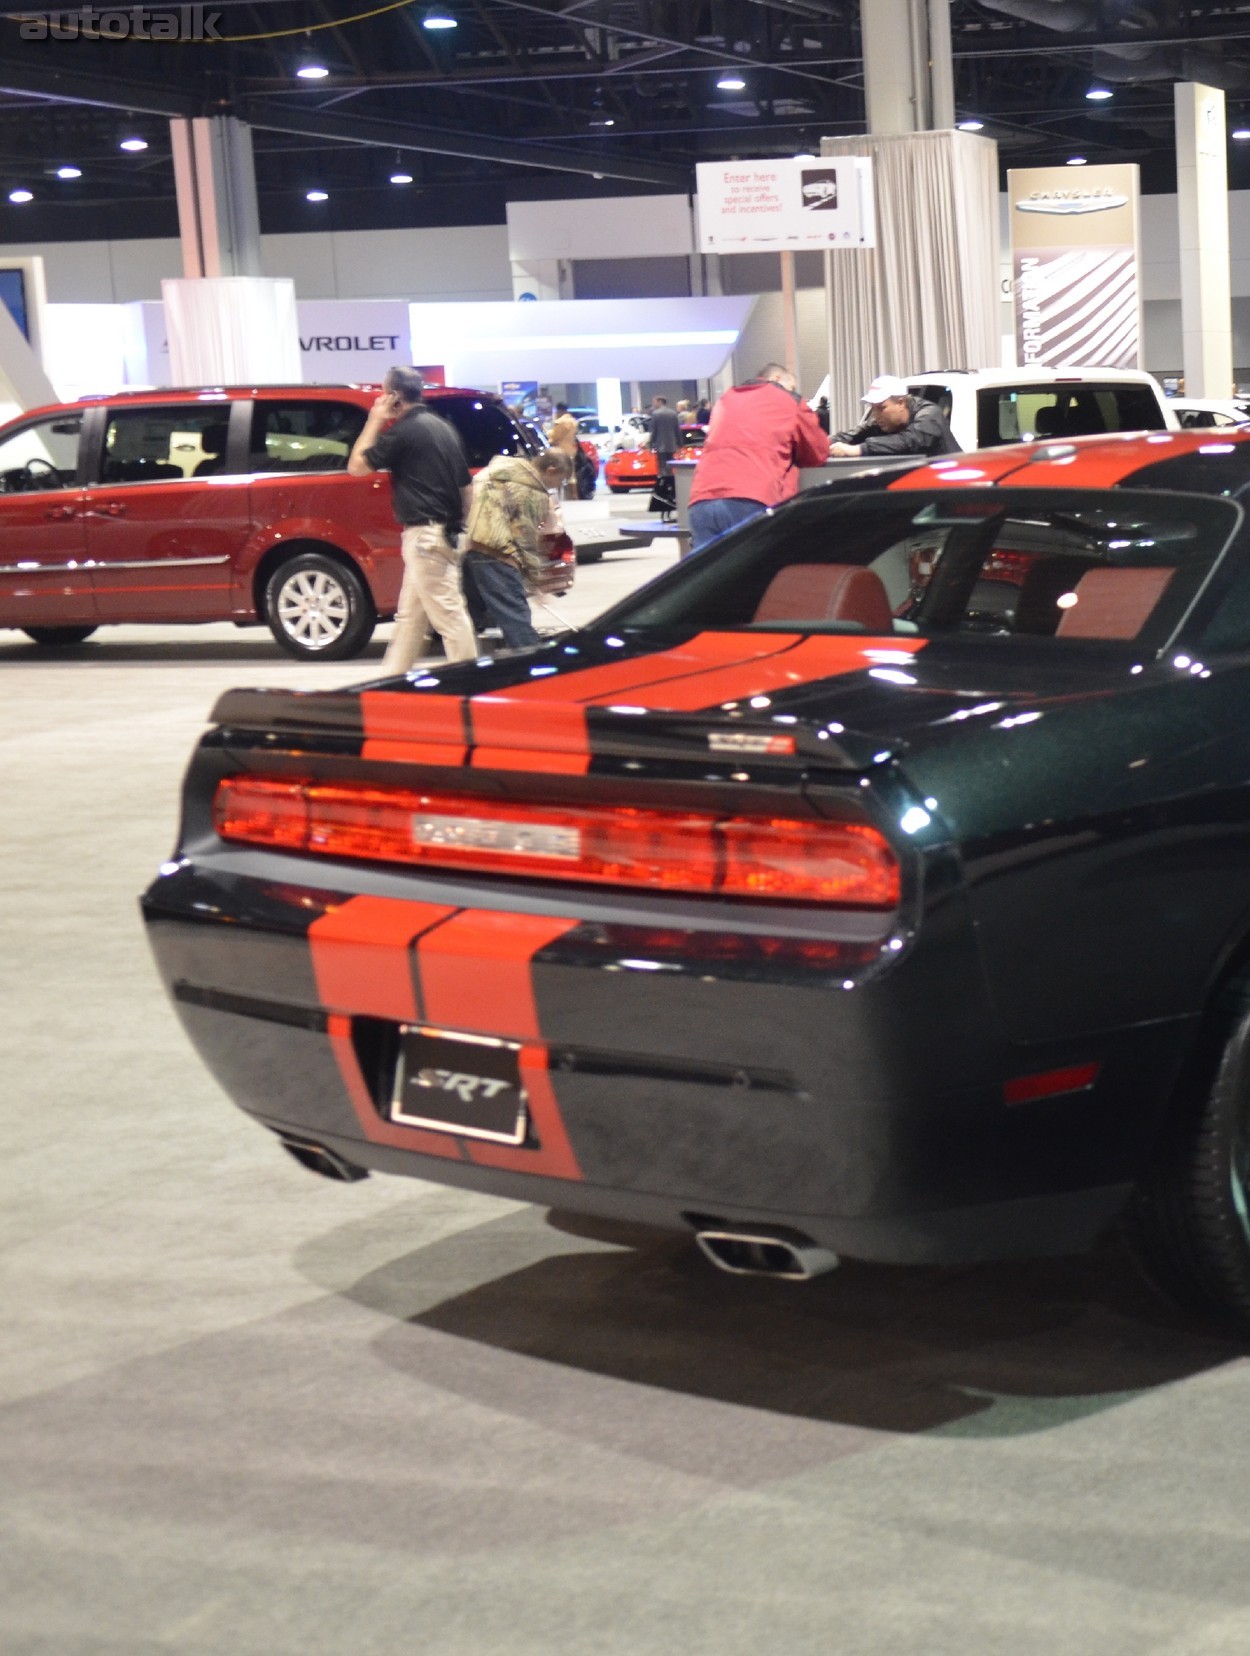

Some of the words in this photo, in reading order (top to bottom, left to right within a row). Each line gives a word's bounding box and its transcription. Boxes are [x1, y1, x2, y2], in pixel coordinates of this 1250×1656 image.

[723, 172, 751, 184] Enter
[754, 171, 777, 183] here
[724, 194, 752, 205] special
[754, 193, 780, 203] offers
[721, 205, 737, 215] and
[410, 1068, 513, 1102] SRT
